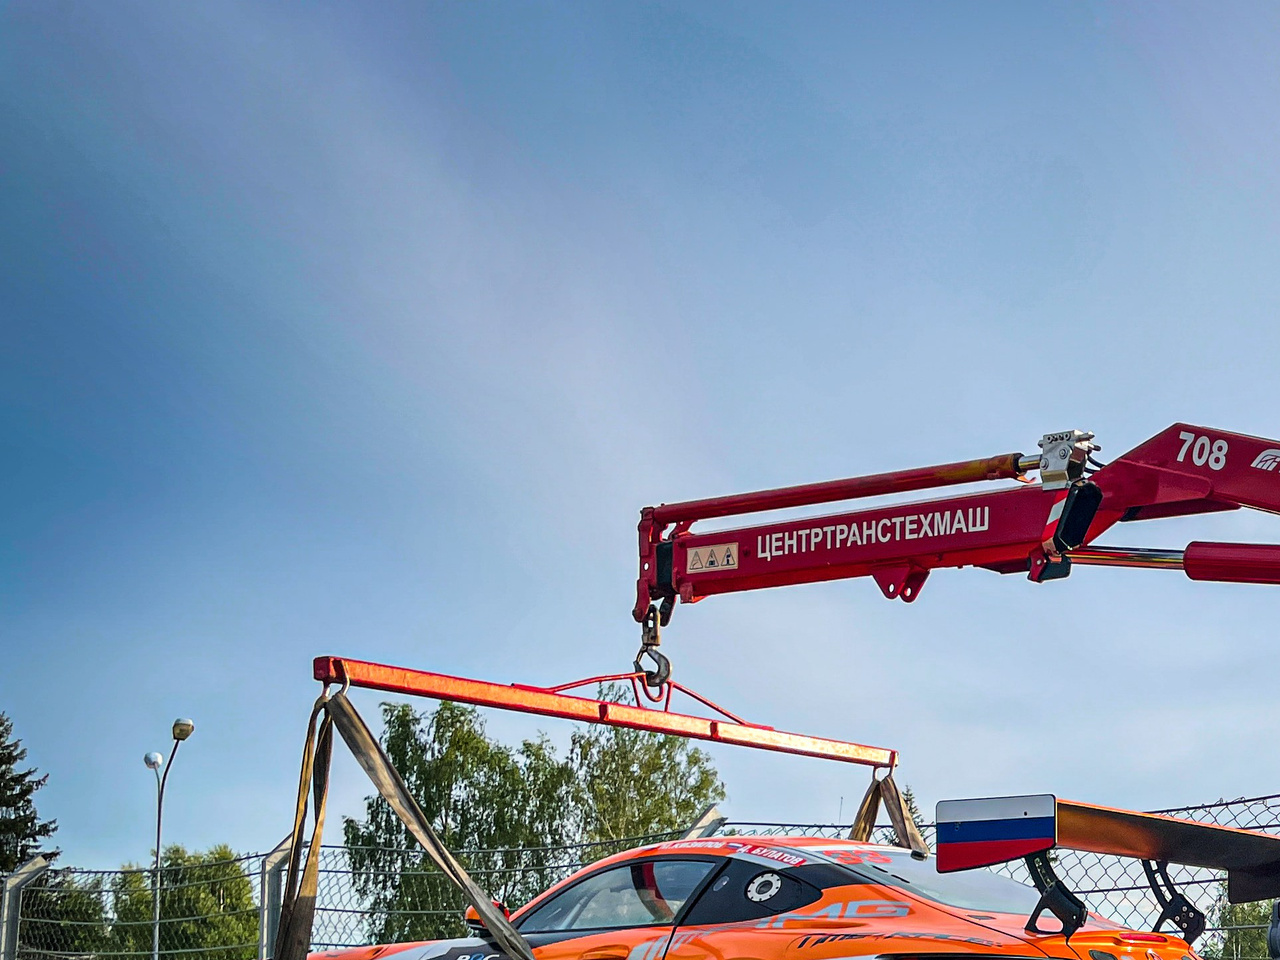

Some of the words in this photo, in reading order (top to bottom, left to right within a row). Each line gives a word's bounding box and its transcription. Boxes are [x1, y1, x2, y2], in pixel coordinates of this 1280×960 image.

[1177, 430, 1229, 471] 708
[756, 506, 990, 562] ЦЕНТРТРАНСТЕХМАШ
[751, 847, 803, 866] БУЛАТОВ
